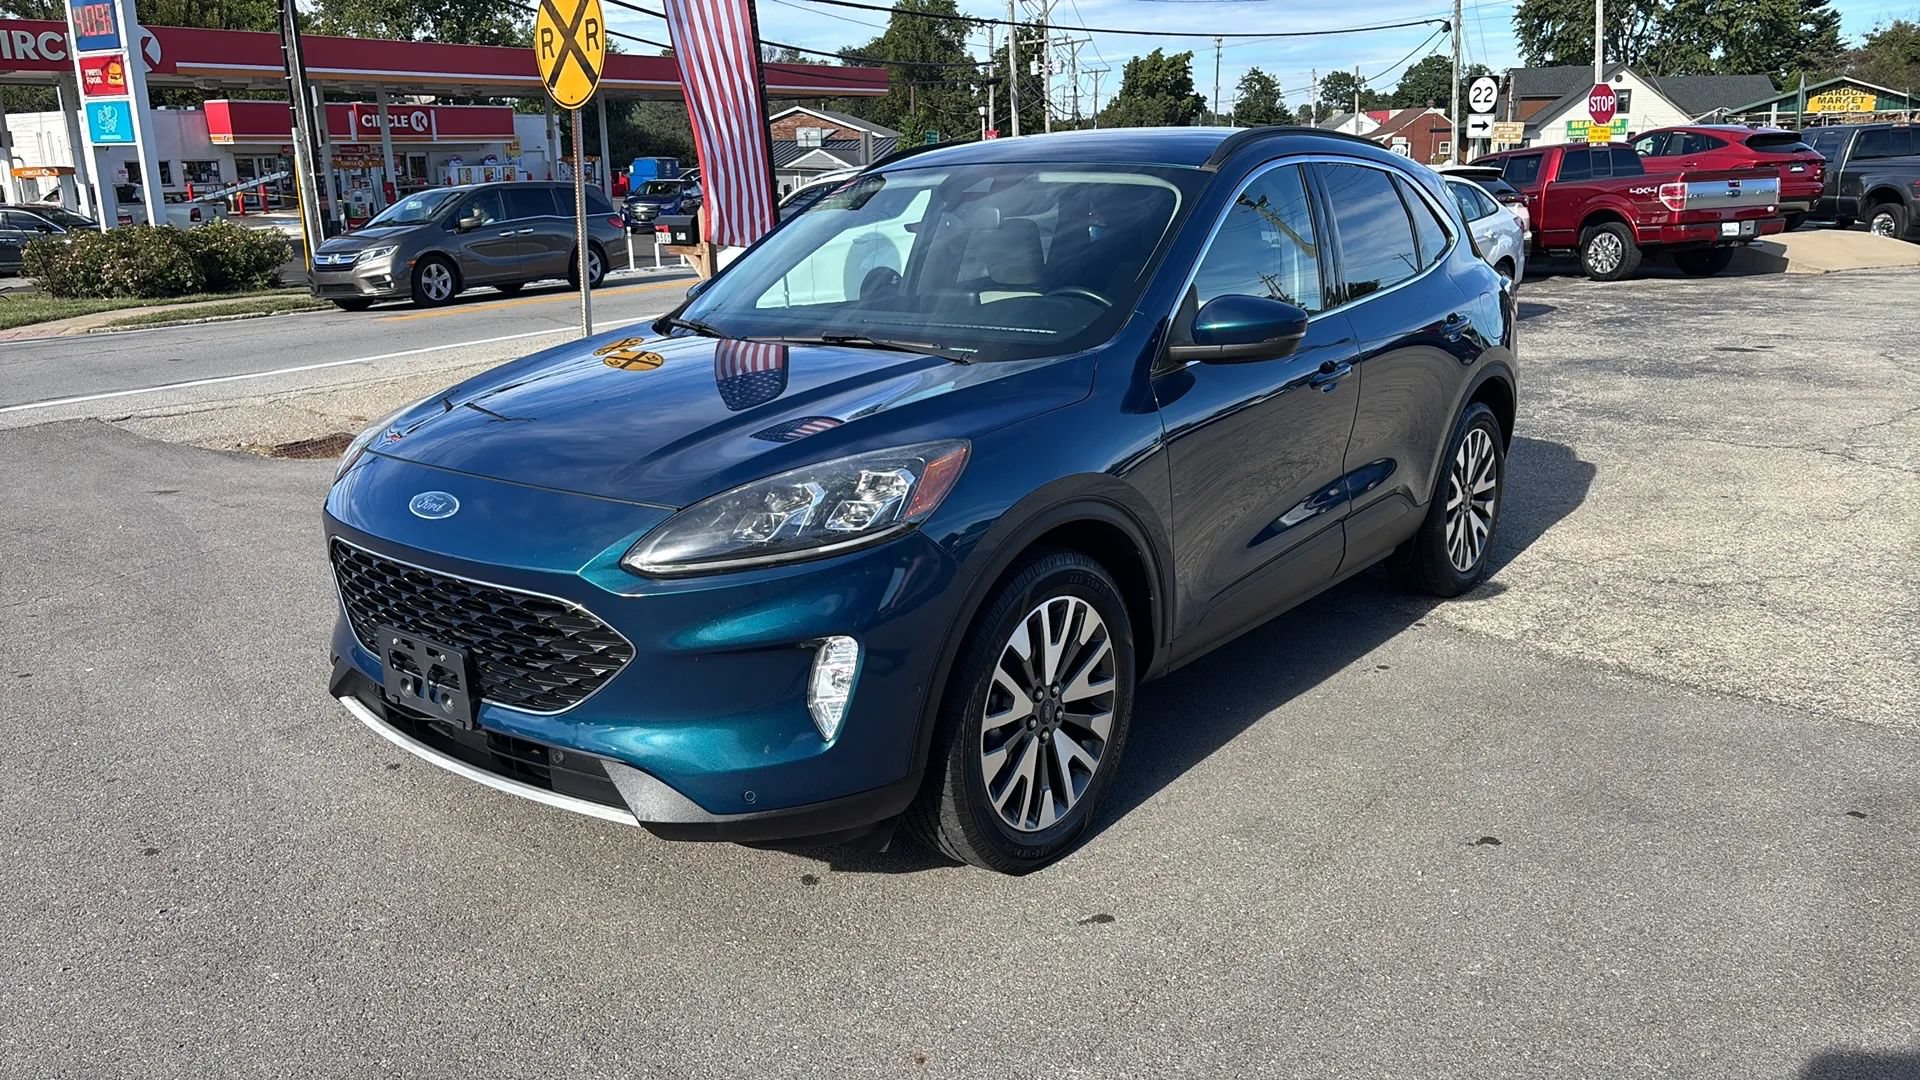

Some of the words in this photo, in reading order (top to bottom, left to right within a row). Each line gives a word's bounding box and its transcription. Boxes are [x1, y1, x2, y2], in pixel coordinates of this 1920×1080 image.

[541, 27, 555, 60] R
[585, 17, 600, 52] R
[1472, 86, 1493, 104] 22
[1590, 95, 1615, 112] STOP
[416, 494, 447, 512] Ford
